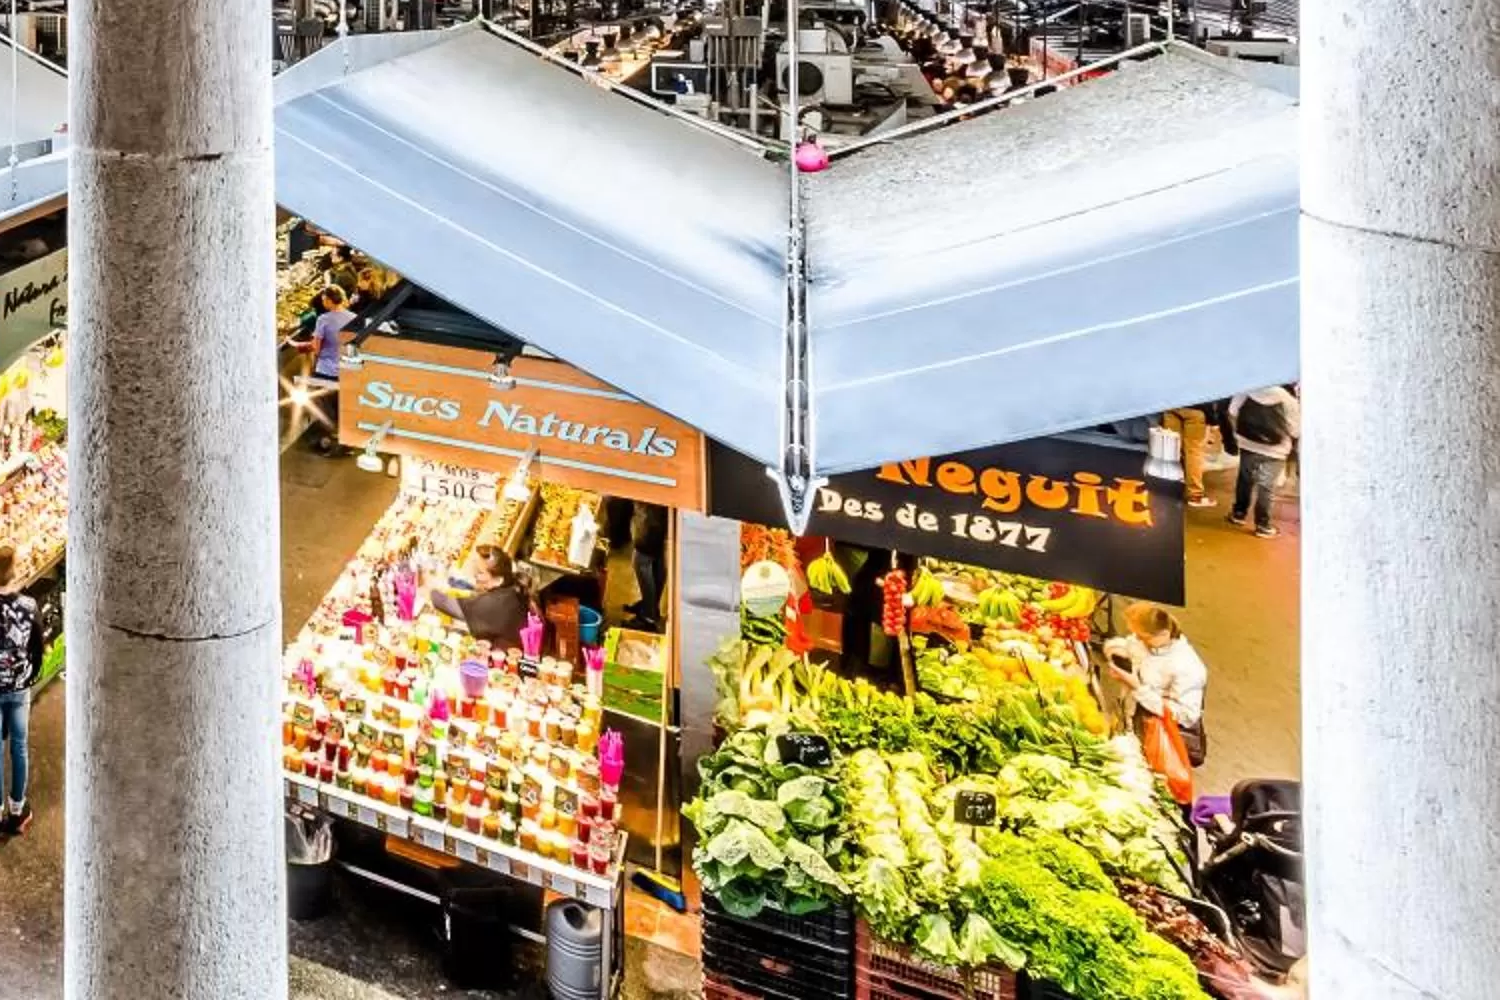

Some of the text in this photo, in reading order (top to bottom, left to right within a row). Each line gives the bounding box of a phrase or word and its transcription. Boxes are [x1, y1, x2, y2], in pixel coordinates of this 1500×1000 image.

[357, 381, 677, 457] Sucs Naturals
[818, 487, 1052, 553] Des de 1877
[875, 456, 1153, 527] Neguit
